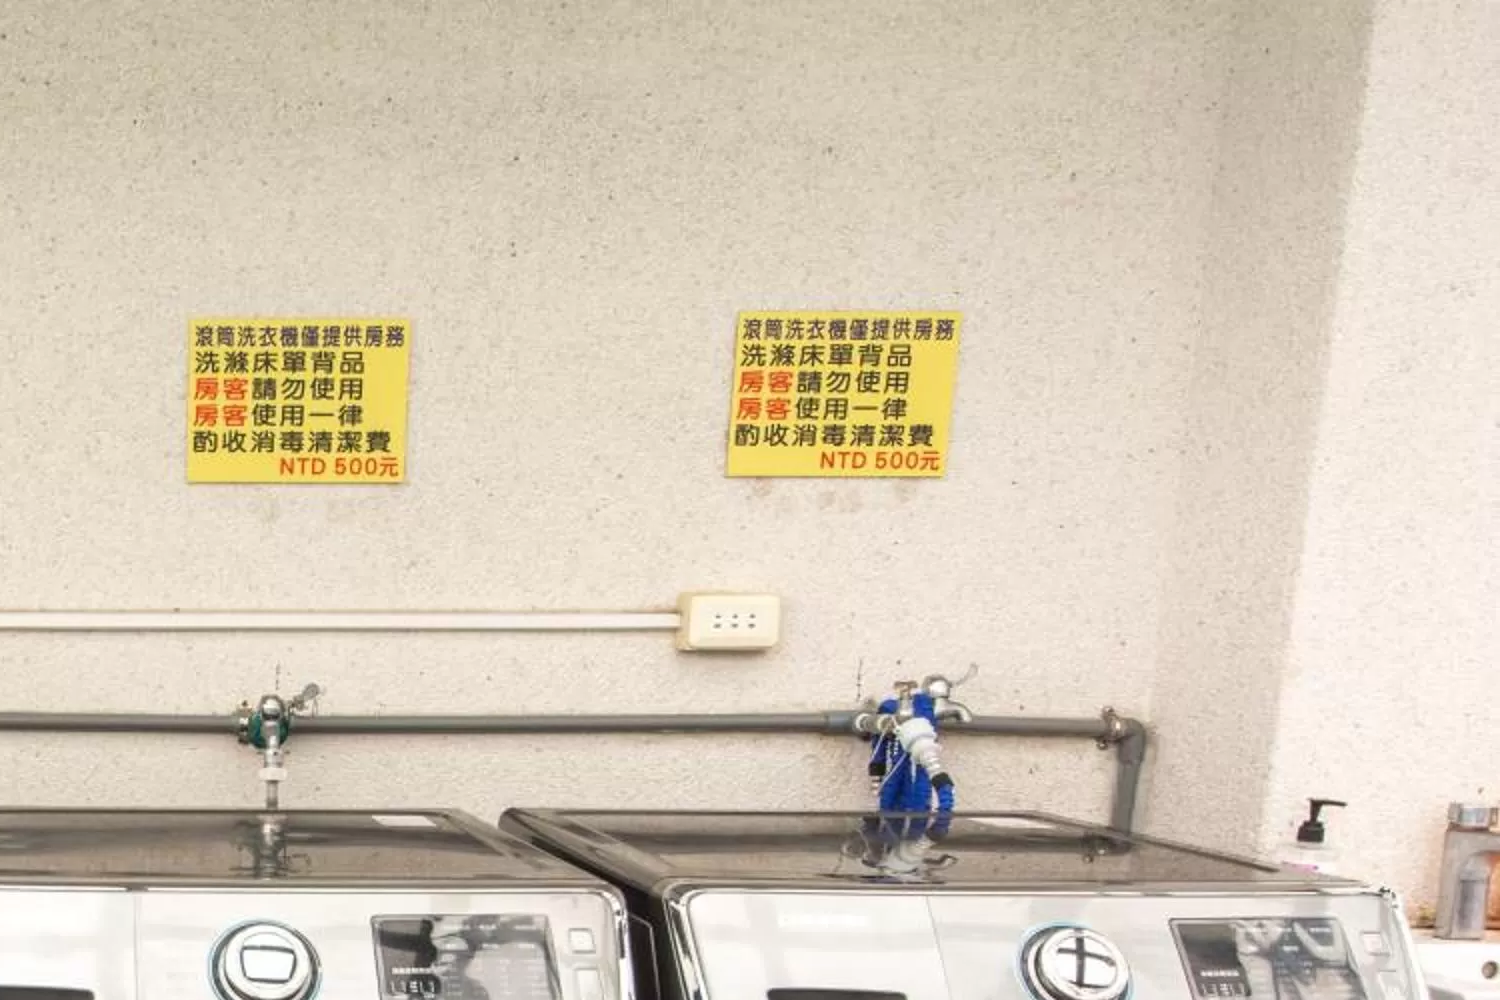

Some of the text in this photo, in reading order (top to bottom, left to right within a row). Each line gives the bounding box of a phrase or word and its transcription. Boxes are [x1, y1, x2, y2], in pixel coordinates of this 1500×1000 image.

[194, 378, 363, 401] 房客請勿使用
[738, 371, 910, 394] 房客請勿使用
[193, 404, 363, 427] 房客使用一律
[736, 397, 907, 421] 房客使用一律
[193, 431, 391, 453] 酌收消毒清潔費
[735, 424, 933, 447] 酌收消毒清潔費
[279, 457, 399, 477] NTD 500元
[820, 451, 941, 471] NTD 500元
